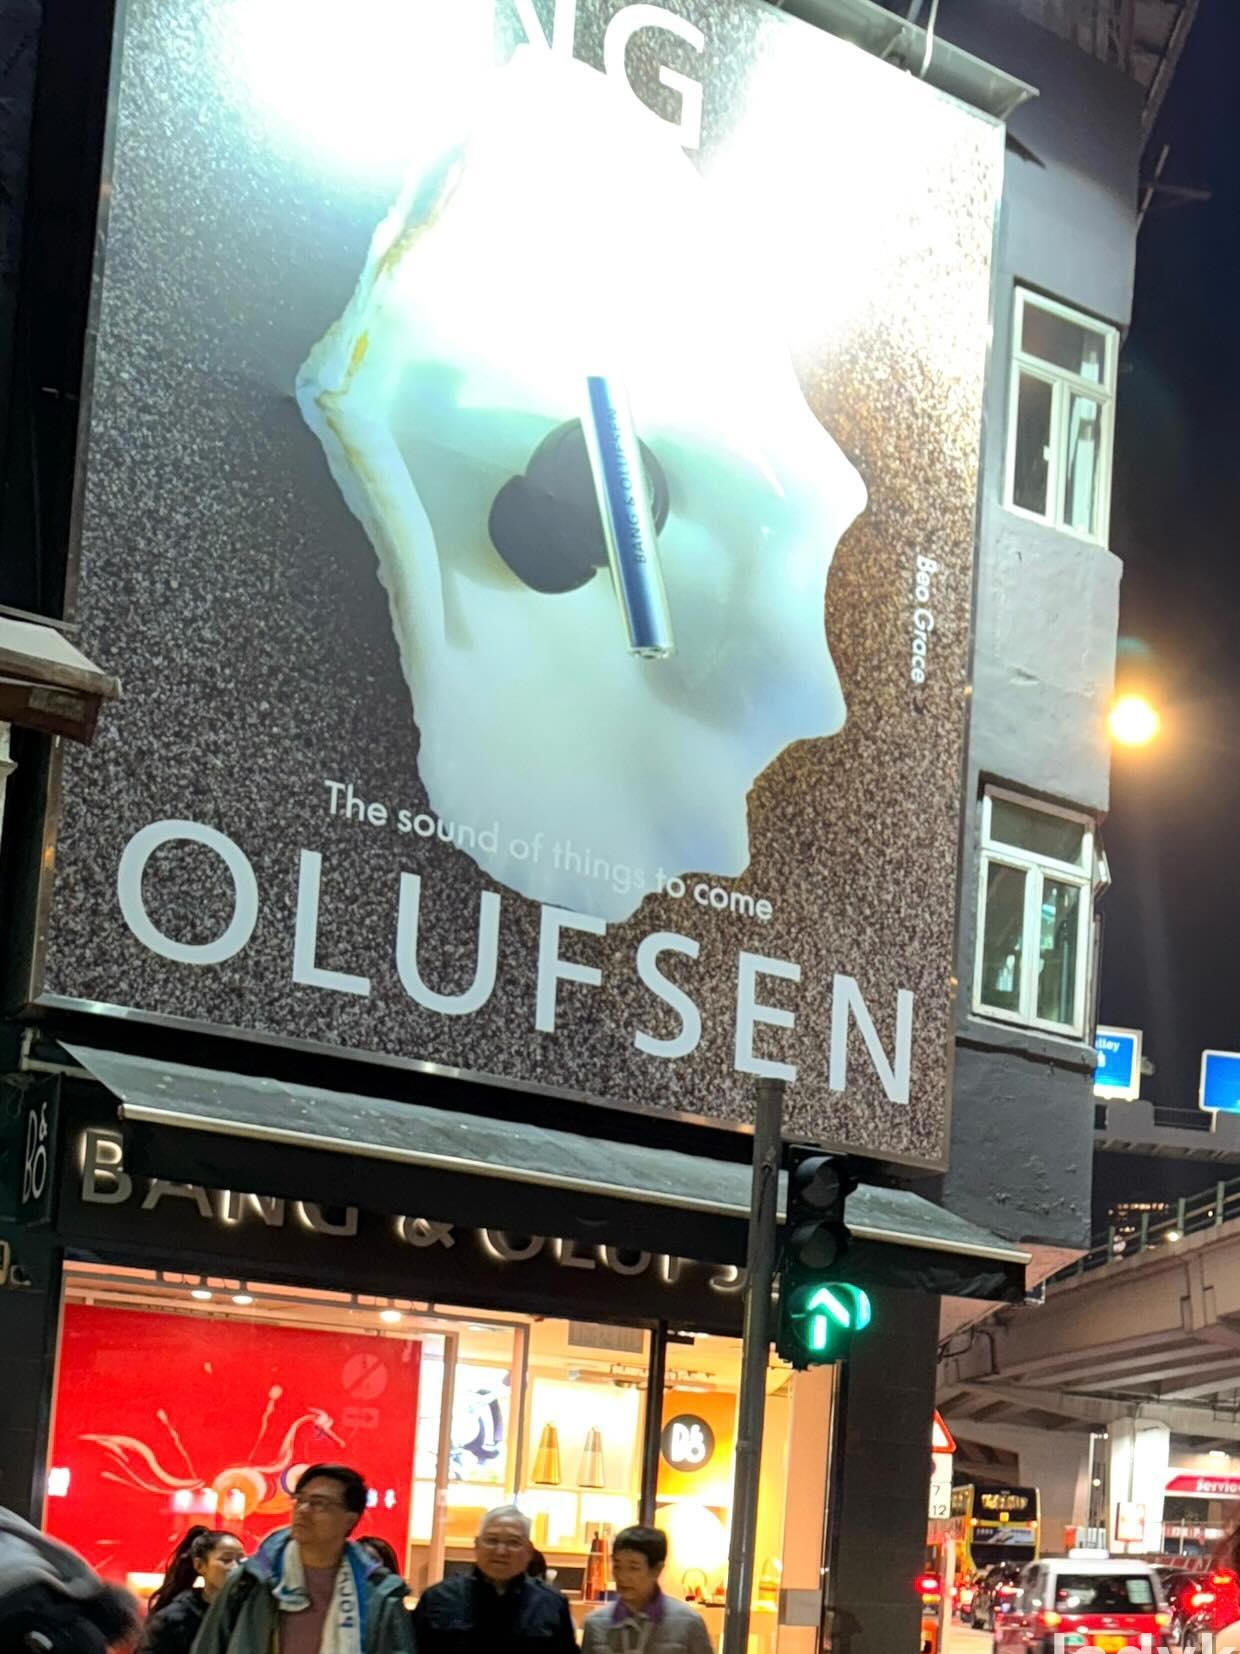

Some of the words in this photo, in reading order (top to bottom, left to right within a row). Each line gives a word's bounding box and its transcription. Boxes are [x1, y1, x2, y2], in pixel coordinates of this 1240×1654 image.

[629, 515, 647, 564] BANG
[915, 555, 938, 602] Beo
[911, 608, 934, 683] Grace
[324, 779, 388, 826] The
[397, 808, 500, 853] sound
[510, 833, 545, 862] of
[552, 839, 645, 894] things
[654, 868, 686, 899] to
[693, 881, 774, 920] come
[117, 819, 915, 1106] OLUFSEN
